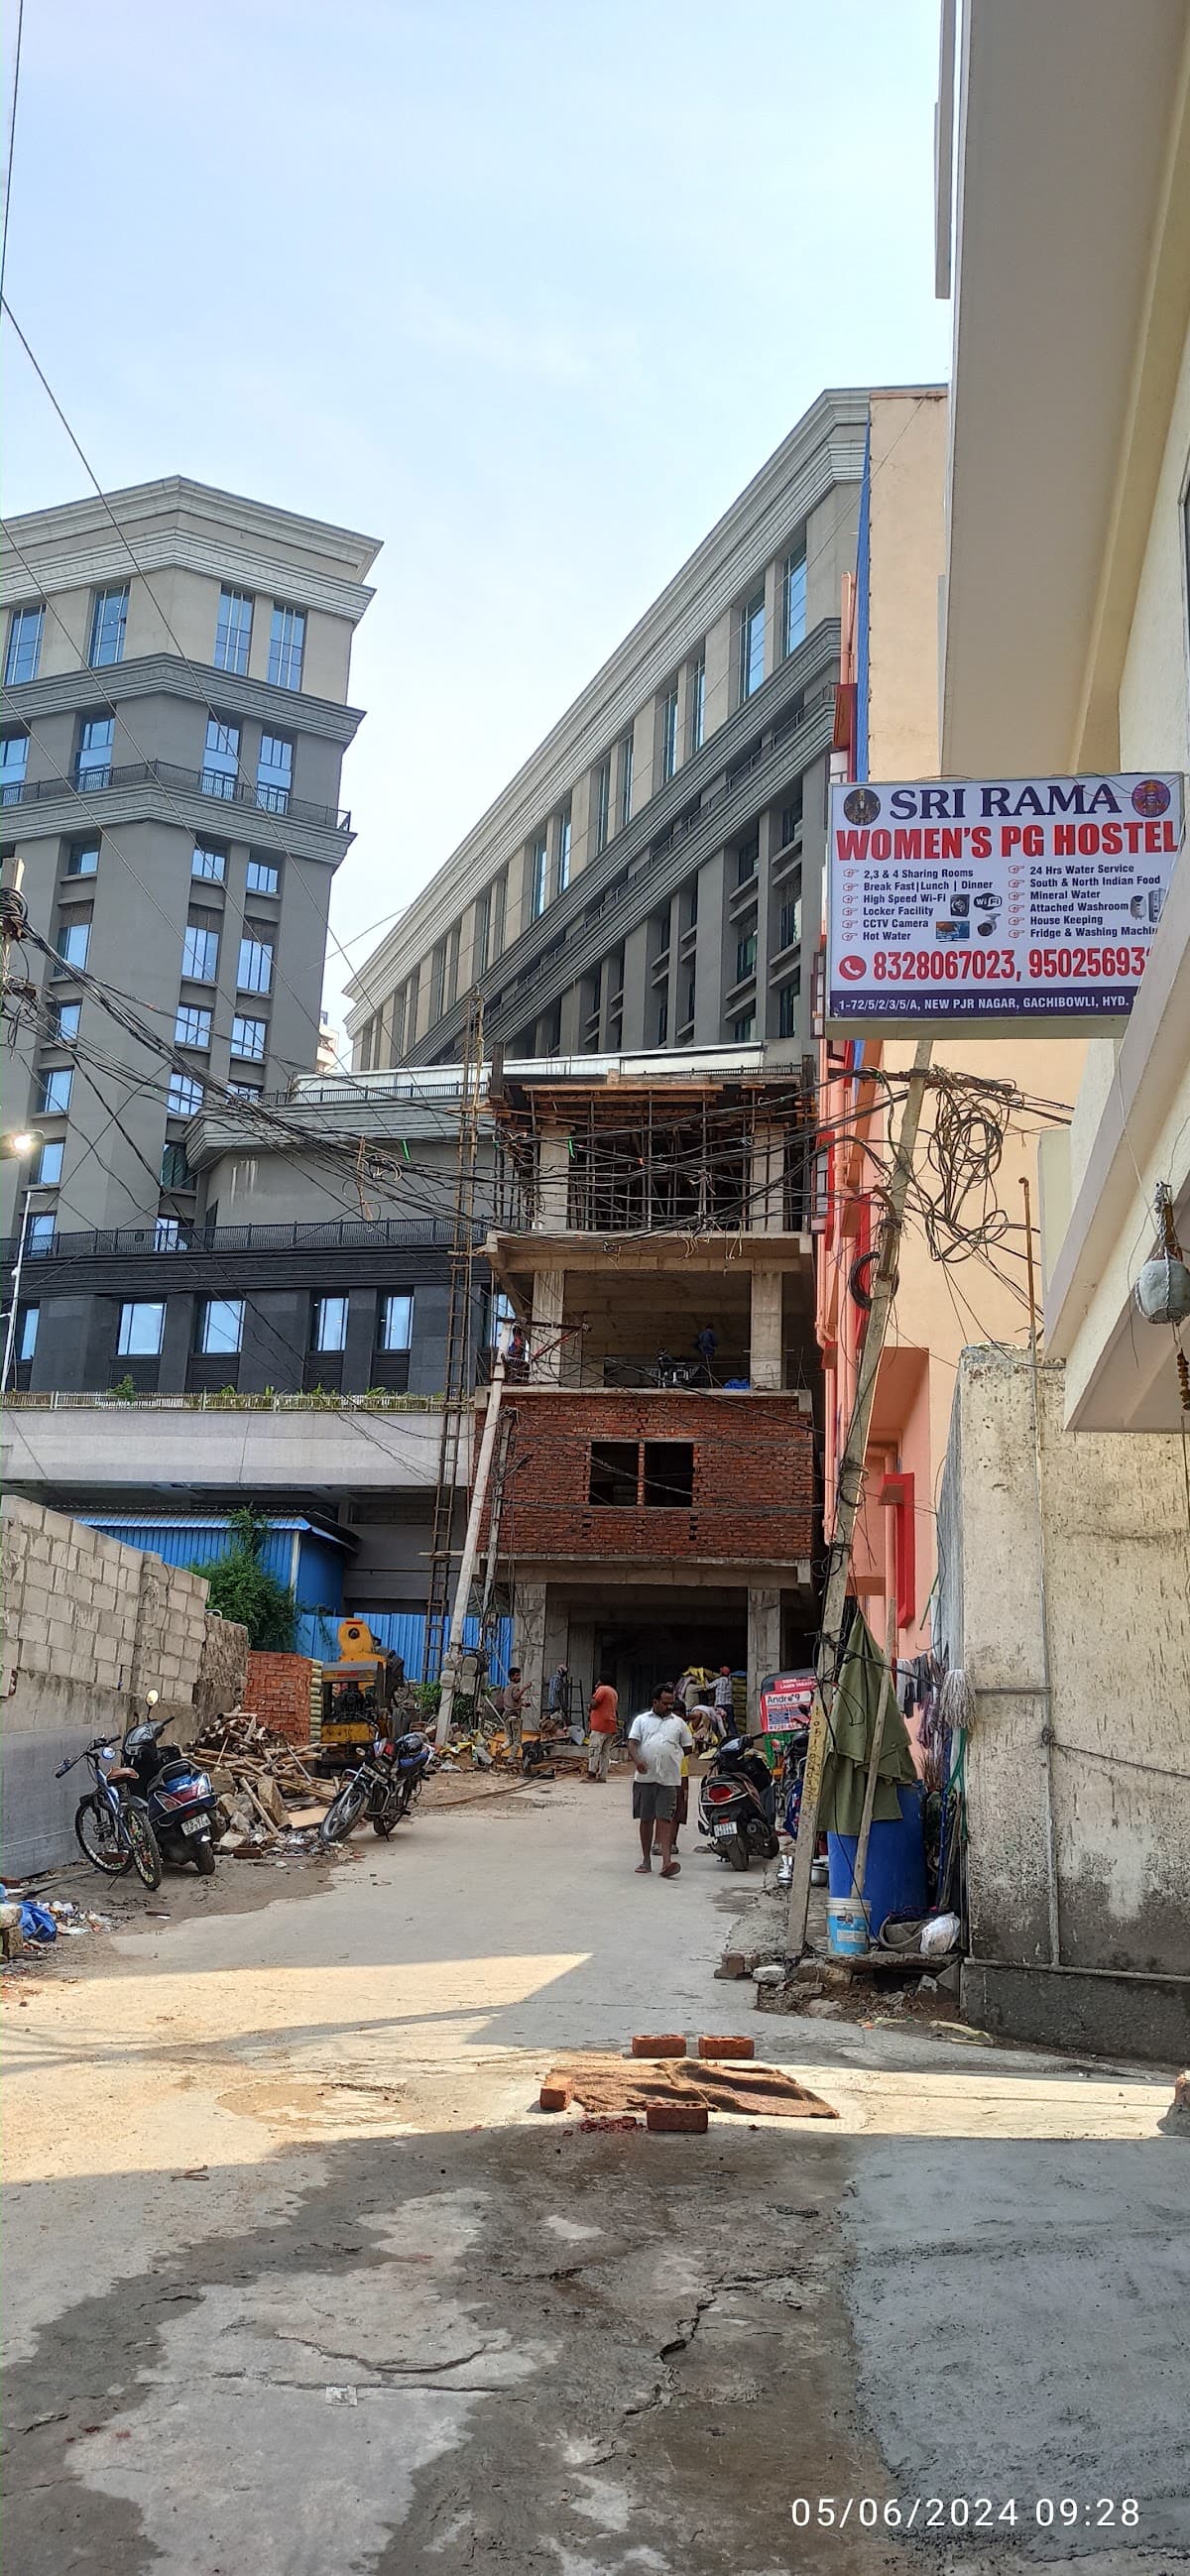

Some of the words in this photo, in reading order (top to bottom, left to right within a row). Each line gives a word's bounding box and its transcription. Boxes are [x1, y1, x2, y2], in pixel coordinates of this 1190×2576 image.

[890, 788, 966, 820] SRI
[980, 783, 1123, 817] RAMA
[836, 826, 992, 861] WOMEN'S
[1002, 824, 1044, 857] PG
[1054, 821, 1178, 856] HOSTEL
[864, 870, 880, 880] 2,3
[882, 870, 890, 878] &
[892, 870, 898, 878] 4
[901, 869, 938, 879] Sharing
[941, 869, 974, 878] Rooms
[1030, 866, 1042, 875] 24
[1045, 866, 1062, 875] Hrs
[1065, 865, 1095, 875] Water
[1098, 864, 1134, 874] Service
[864, 881, 892, 891] Break
[962, 880, 993, 889] Dinner
[1030, 878, 1058, 888] South
[1061, 878, 1069, 886] &
[1072, 877, 1099, 886] North
[1103, 876, 1133, 885] Indian
[1137, 875, 1160, 884] Food
[864, 894, 886, 904] High
[888, 893, 917, 904] Speed
[920, 893, 946, 903] Wi-Fi
[1030, 890, 1068, 900] Mineral
[1071, 889, 1101, 899] Water
[863, 906, 894, 916] Locker
[897, 906, 933, 917] Facility
[1030, 903, 1074, 912] Attached
[1078, 901, 1129, 911] Washroom
[863, 918, 889, 928] CCTV
[892, 918, 929, 928] Camera
[1030, 916, 1061, 925] House
[1063, 914, 1103, 926] Keeping
[863, 931, 880, 941] Hot
[882, 931, 911, 941] Water
[1030, 928, 1061, 939] Fridge
[1064, 927, 1072, 937] &
[1075, 926, 1118, 938] Washing
[874, 949, 1021, 982] 8328067023,
[1028, 946, 1150, 979] 95025693
[839, 998, 921, 1011] 1-72/5/2/3/5/A,
[924, 998, 949, 1009] NEW
[953, 998, 975, 1009] PJR
[978, 996, 1020, 1009] NAGAR,
[1022, 995, 1099, 1009] GACHIBOWLI,
[1102, 995, 1130, 1006] HYD.
